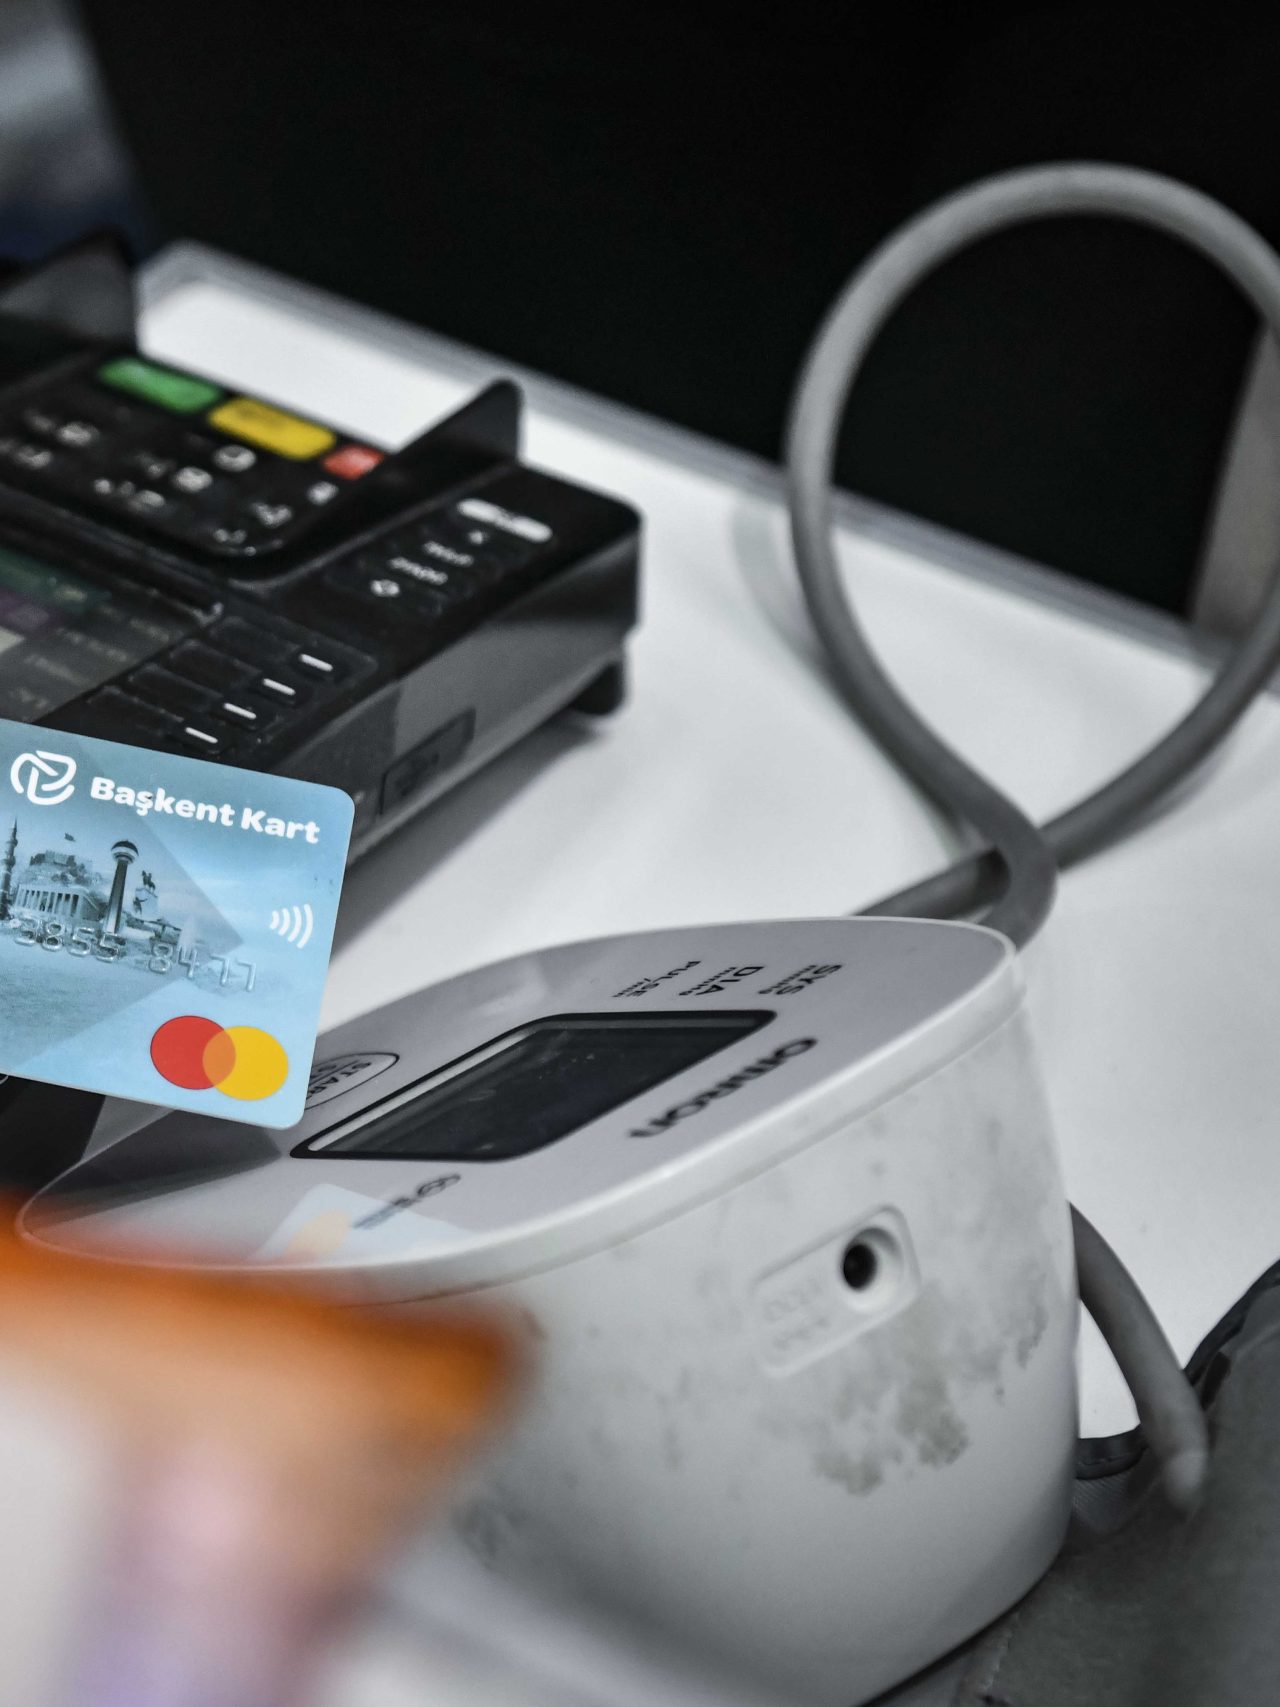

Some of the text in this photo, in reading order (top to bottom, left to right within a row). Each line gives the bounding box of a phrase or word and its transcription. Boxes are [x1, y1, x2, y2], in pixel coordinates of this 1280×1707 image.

[90, 777, 320, 844] Başkent Kart
[146, 943, 260, 992] 8477
[626, 960, 701, 997] PULSE
[695, 966, 764, 995] DIA
[776, 964, 842, 995] SYS
[628, 1037, 818, 1138] OMRON
